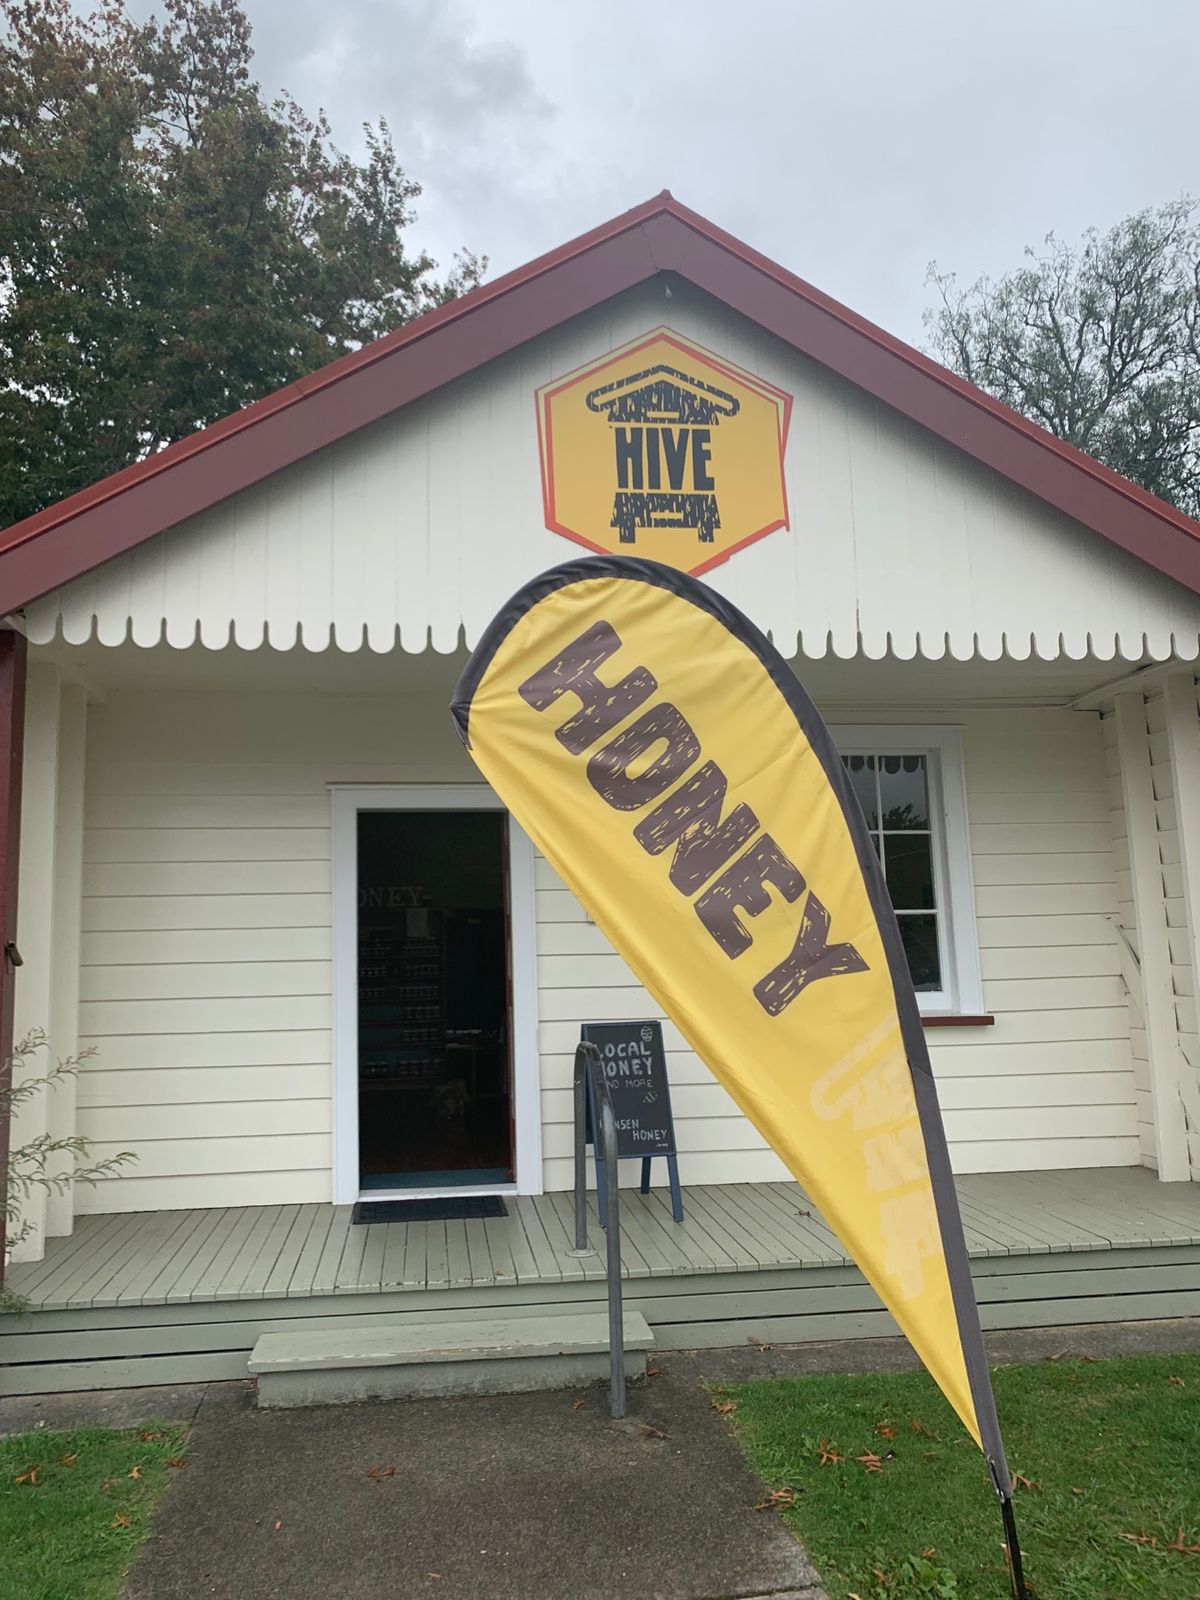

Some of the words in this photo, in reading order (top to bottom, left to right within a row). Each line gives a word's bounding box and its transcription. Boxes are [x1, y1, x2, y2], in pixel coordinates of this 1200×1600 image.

[614, 427, 715, 491] HIVE
[518, 619, 870, 1016] HONEY
[600, 1041, 651, 1057] OCAL
[625, 1078, 654, 1088] MORE
[632, 1129, 668, 1141] HONEY
